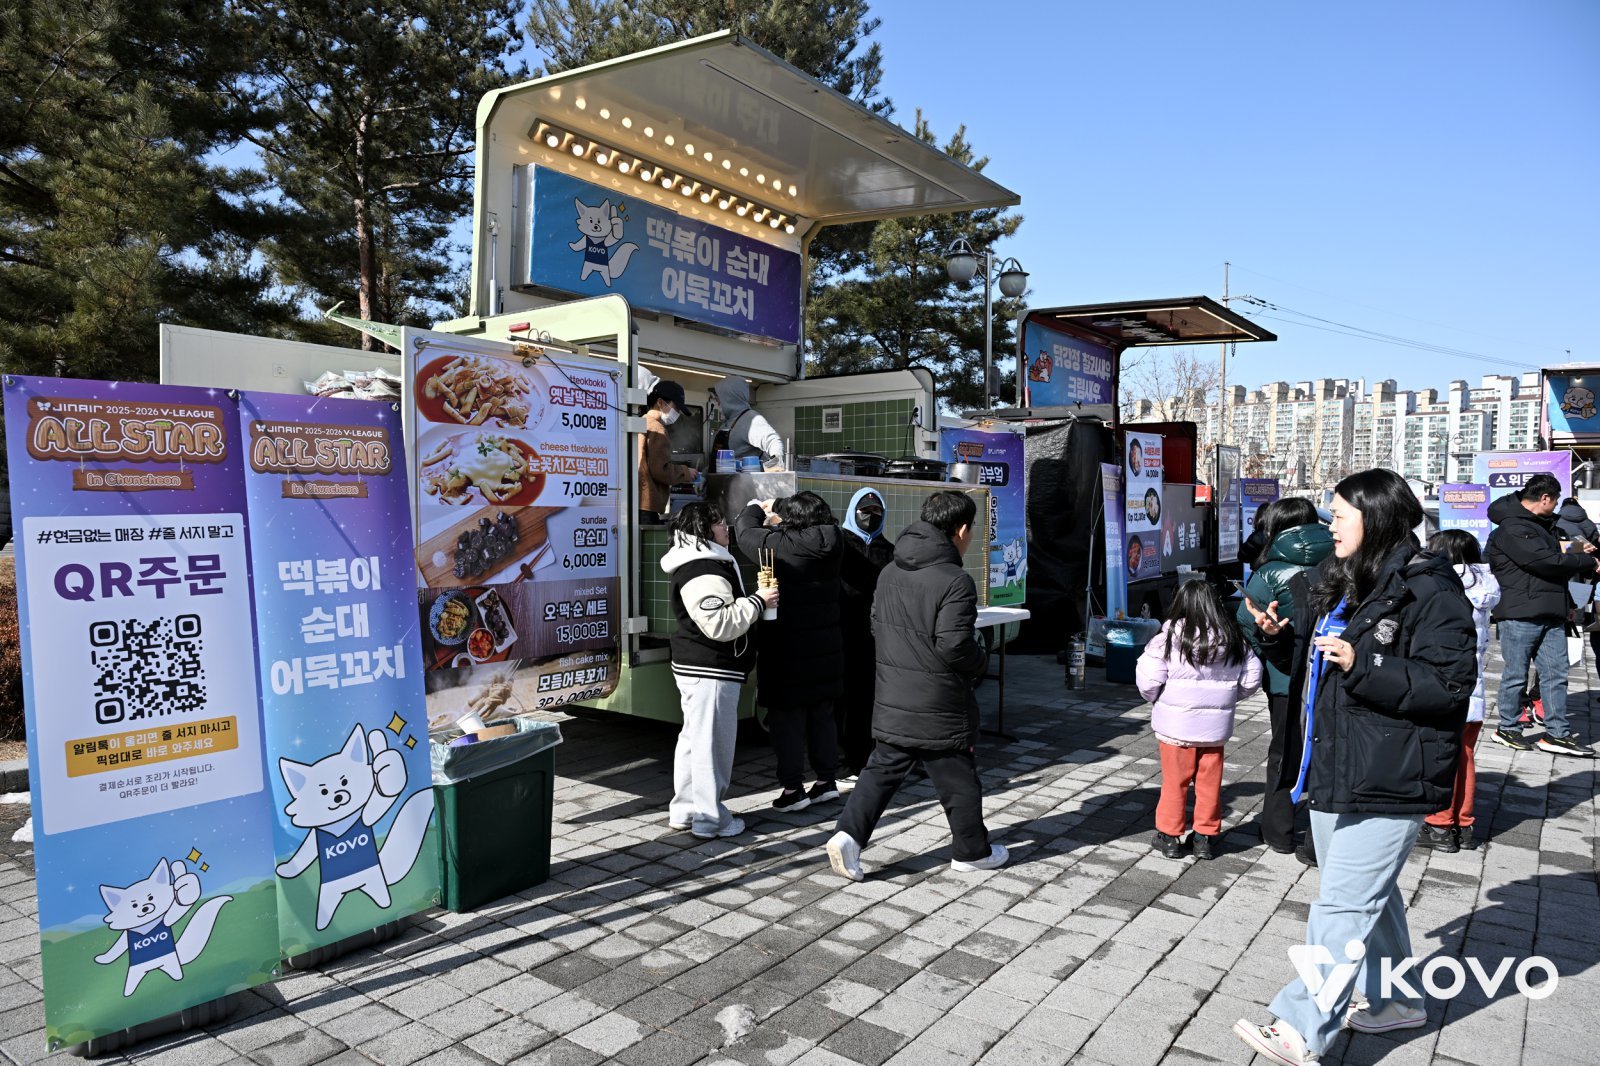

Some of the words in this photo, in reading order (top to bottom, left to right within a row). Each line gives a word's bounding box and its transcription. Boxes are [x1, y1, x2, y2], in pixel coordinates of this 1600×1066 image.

[588, 246, 606, 255] KOVO
[646, 216, 720, 272] 떡볶이
[726, 245, 770, 286] 순대
[661, 267, 754, 321] 어묵꼬치
[569, 375, 607, 388] tteokbokki
[550, 386, 607, 410] 옛날떡볶이
[53, 403, 102, 413] JINAIR
[106, 405, 158, 415] 2025~2026
[161, 408, 215, 419] V-LEAGUE
[561, 412, 607, 431] 5,000원
[34, 416, 121, 454] ALL
[120, 417, 224, 457] STAR
[343, 429, 383, 438] V-LEAGUE
[254, 436, 316, 467] ALL
[315, 438, 390, 469] STAR
[540, 442, 569, 452] cheese
[571, 443, 608, 455] tteokbokki
[527, 455, 609, 476] 눈꽃치즈떡볶이
[87, 473, 103, 486] In
[105, 473, 181, 486] Chuncheon
[563, 481, 607, 498] 7,000원
[581, 516, 607, 525] sundae
[37, 529, 112, 544] #현금없는
[115, 528, 144, 542] 매장
[148, 526, 176, 540] #줄
[180, 526, 205, 539] 서지
[208, 525, 234, 539] 말고
[574, 529, 607, 547] 찰순대
[563, 552, 607, 571] 6,000원
[54, 554, 226, 602] QR주문
[278, 556, 381, 596] 떡볶이
[574, 587, 594, 596] mixed
[595, 586, 607, 595] Set
[585, 599, 608, 617] 세트
[301, 602, 370, 644] 순대
[556, 621, 608, 644] 15,000원
[270, 645, 406, 695] 어묵꼬치
[559, 657, 573, 667] fish
[575, 655, 593, 665] cake
[595, 653, 608, 662] mix
[73, 738, 121, 756] 알림톡이
[125, 732, 158, 748] 울리면
[161, 730, 172, 741] 줄
[177, 726, 197, 738] 서지
[200, 720, 231, 734] 마시고
[96, 749, 143, 766] 픽업대로
[146, 746, 169, 759] 바로
[172, 738, 213, 754] 와주세요
[99, 775, 142, 792] 결제순서로
[145, 771, 170, 783] 조리가
[173, 763, 215, 778] 시작됩니다.
[119, 785, 158, 799] QR주문이
[161, 782, 169, 791] 더
[171, 778, 198, 790] 빨라요!
[325, 834, 369, 859] KOVO
[134, 931, 168, 951] KOVO
